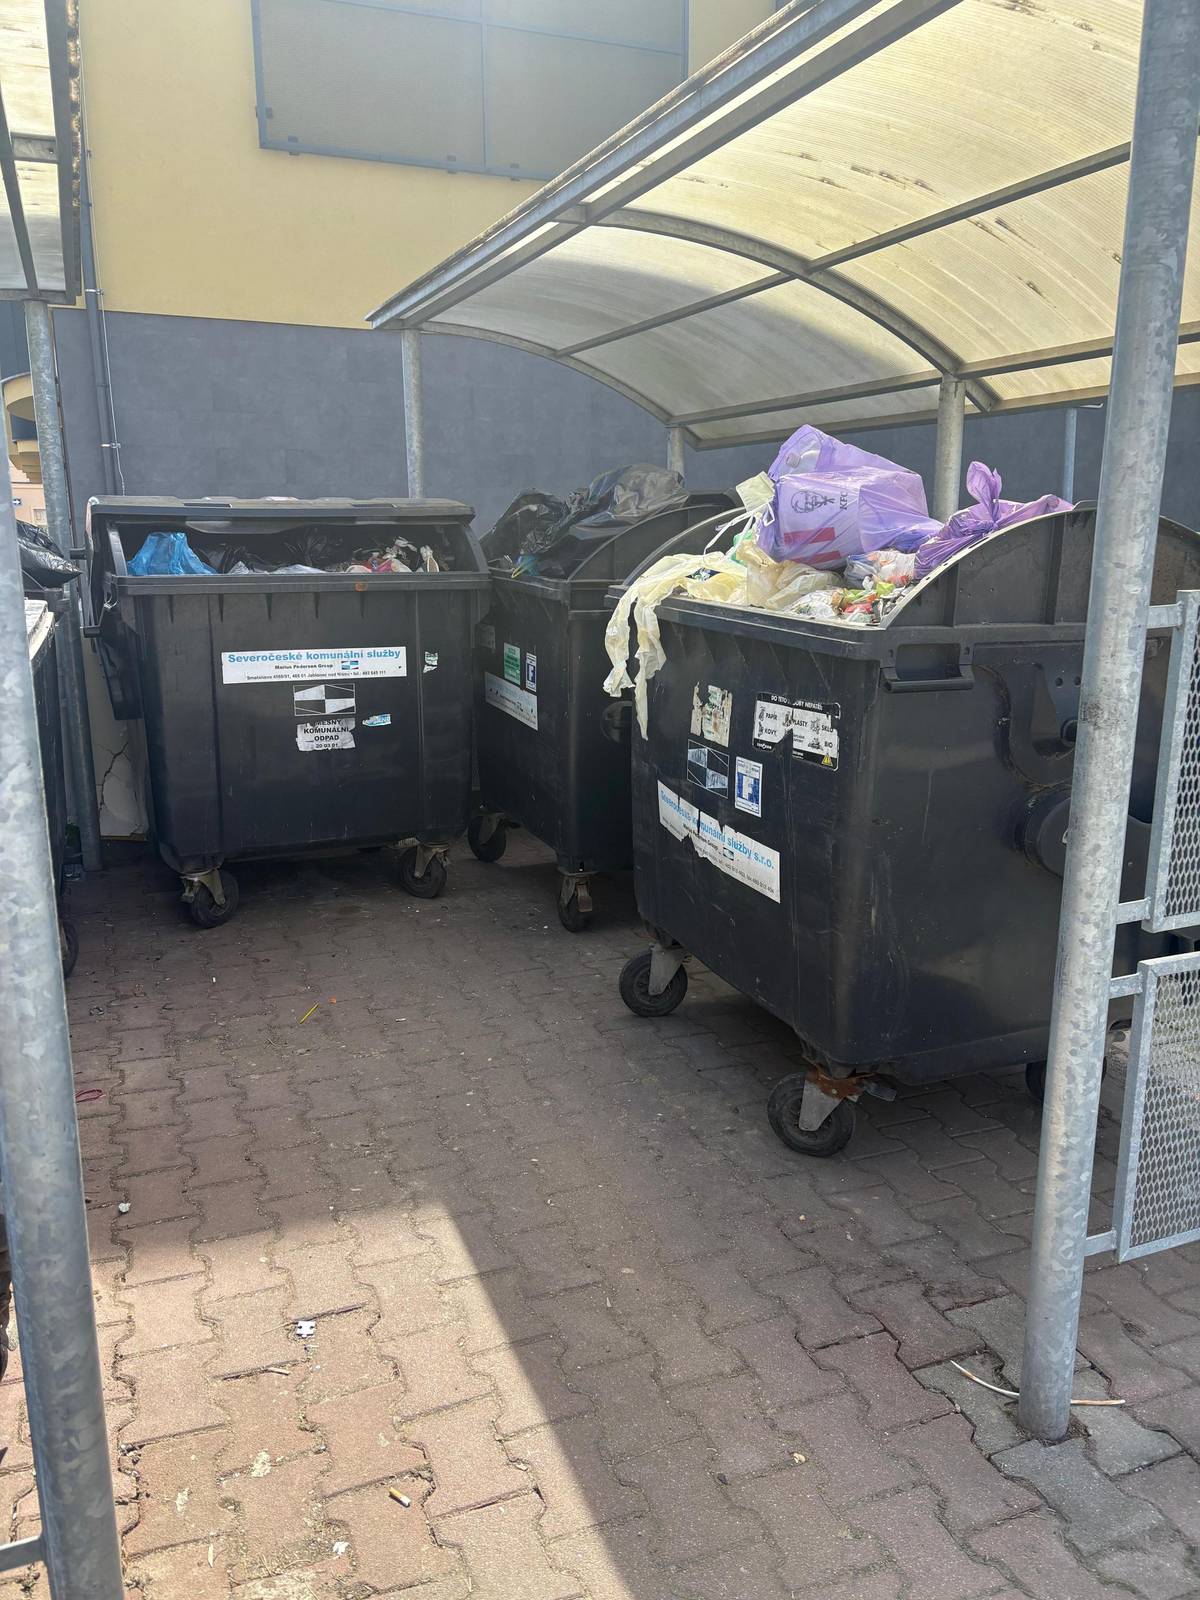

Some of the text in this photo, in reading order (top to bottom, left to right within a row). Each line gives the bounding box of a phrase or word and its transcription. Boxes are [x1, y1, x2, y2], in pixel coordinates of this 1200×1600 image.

[839, 492, 848, 510] KFC
[228, 649, 401, 663] Severočeské komunální služby
[314, 734, 340, 742] ODPAD
[824, 740, 833, 748] BIO
[727, 836, 752, 859] služby
[754, 851, 774, 870] s.r.o.
